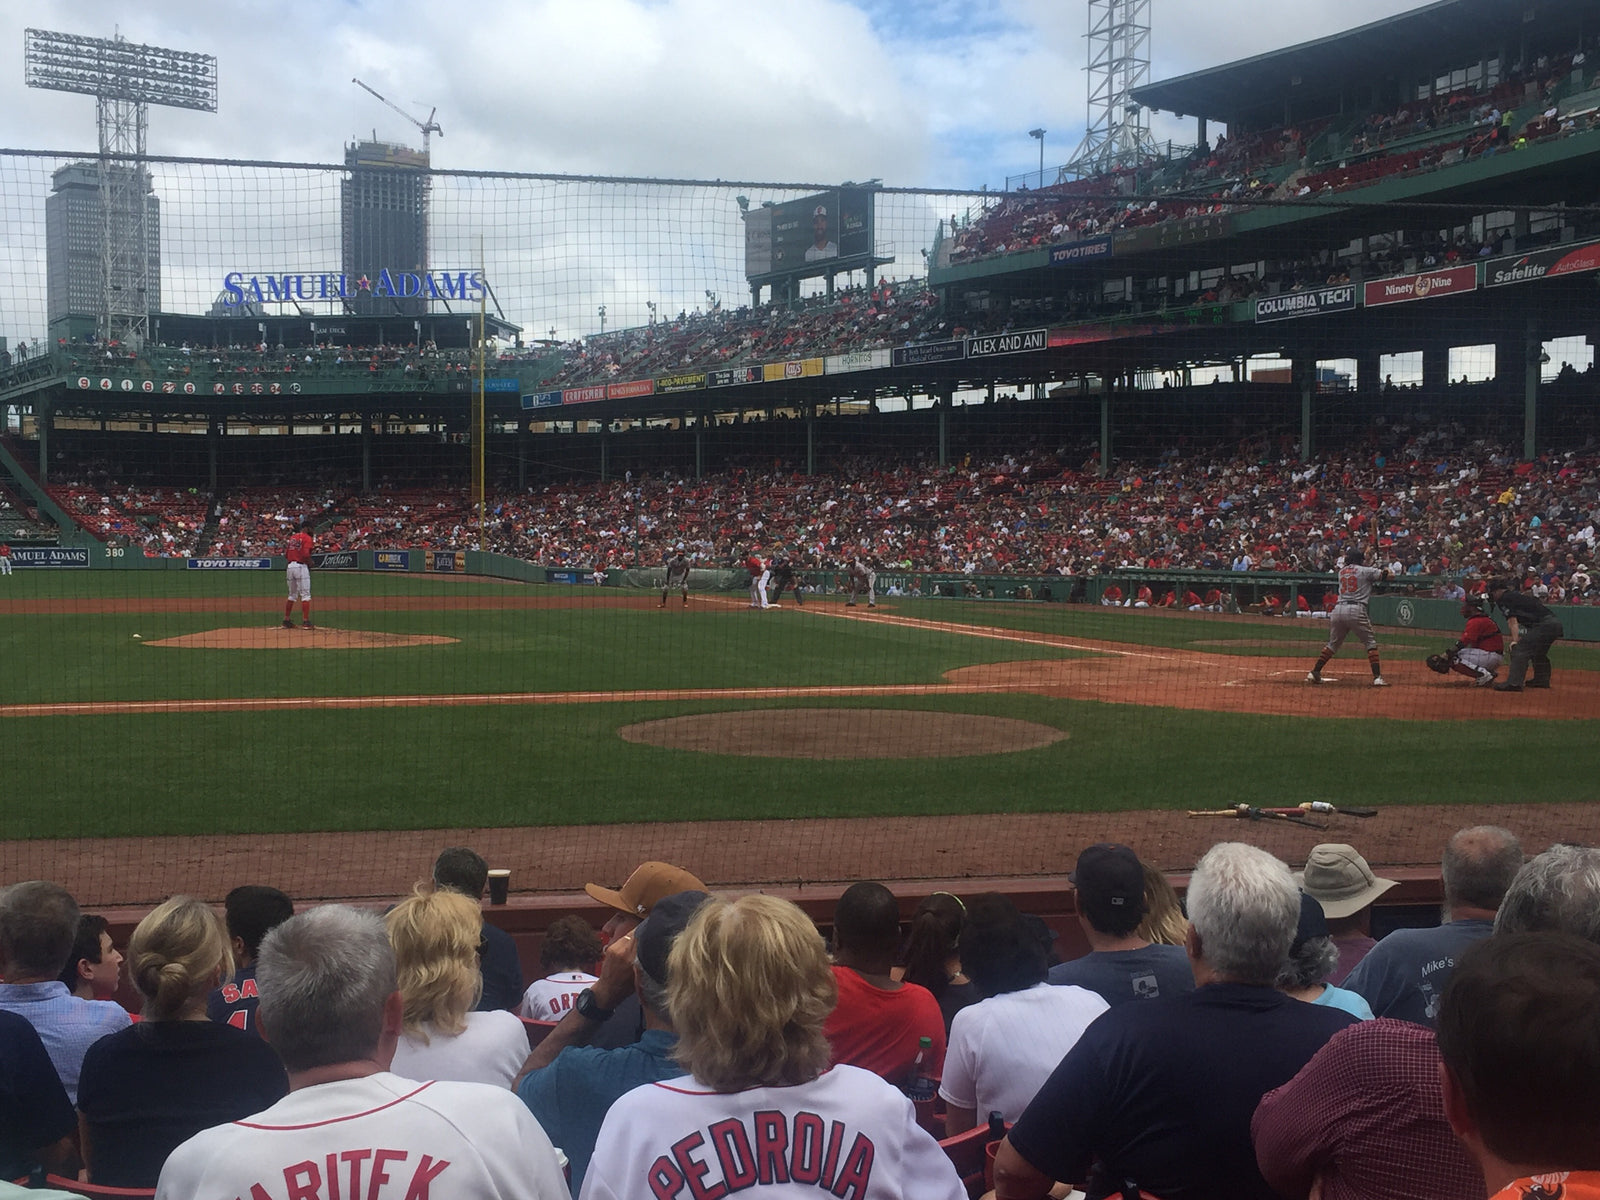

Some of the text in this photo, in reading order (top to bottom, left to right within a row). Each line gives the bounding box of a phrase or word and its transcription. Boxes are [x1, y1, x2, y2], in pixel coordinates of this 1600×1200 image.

[1053, 243, 1107, 261] TOYO TIRES
[1495, 265, 1546, 283] Safelite
[224, 267, 487, 308] SAMUEL ADAMS
[1385, 283, 1414, 296] Ninety
[1431, 277, 1452, 289] Nine
[1257, 288, 1351, 315] COLUMBIA TECH
[972, 333, 1043, 355] ALEX AND ANI
[80, 379, 89, 389] 9
[102, 379, 110, 389] 4
[565, 389, 604, 402] CRAFTSMAN
[12, 551, 86, 561] AMUEL ADAMS
[105, 548, 124, 557] 380
[1421, 956, 1455, 978] Mike's
[221, 979, 259, 1003] SA
[549, 992, 580, 1015] ORT
[647, 1109, 875, 1200] PEDROIA
